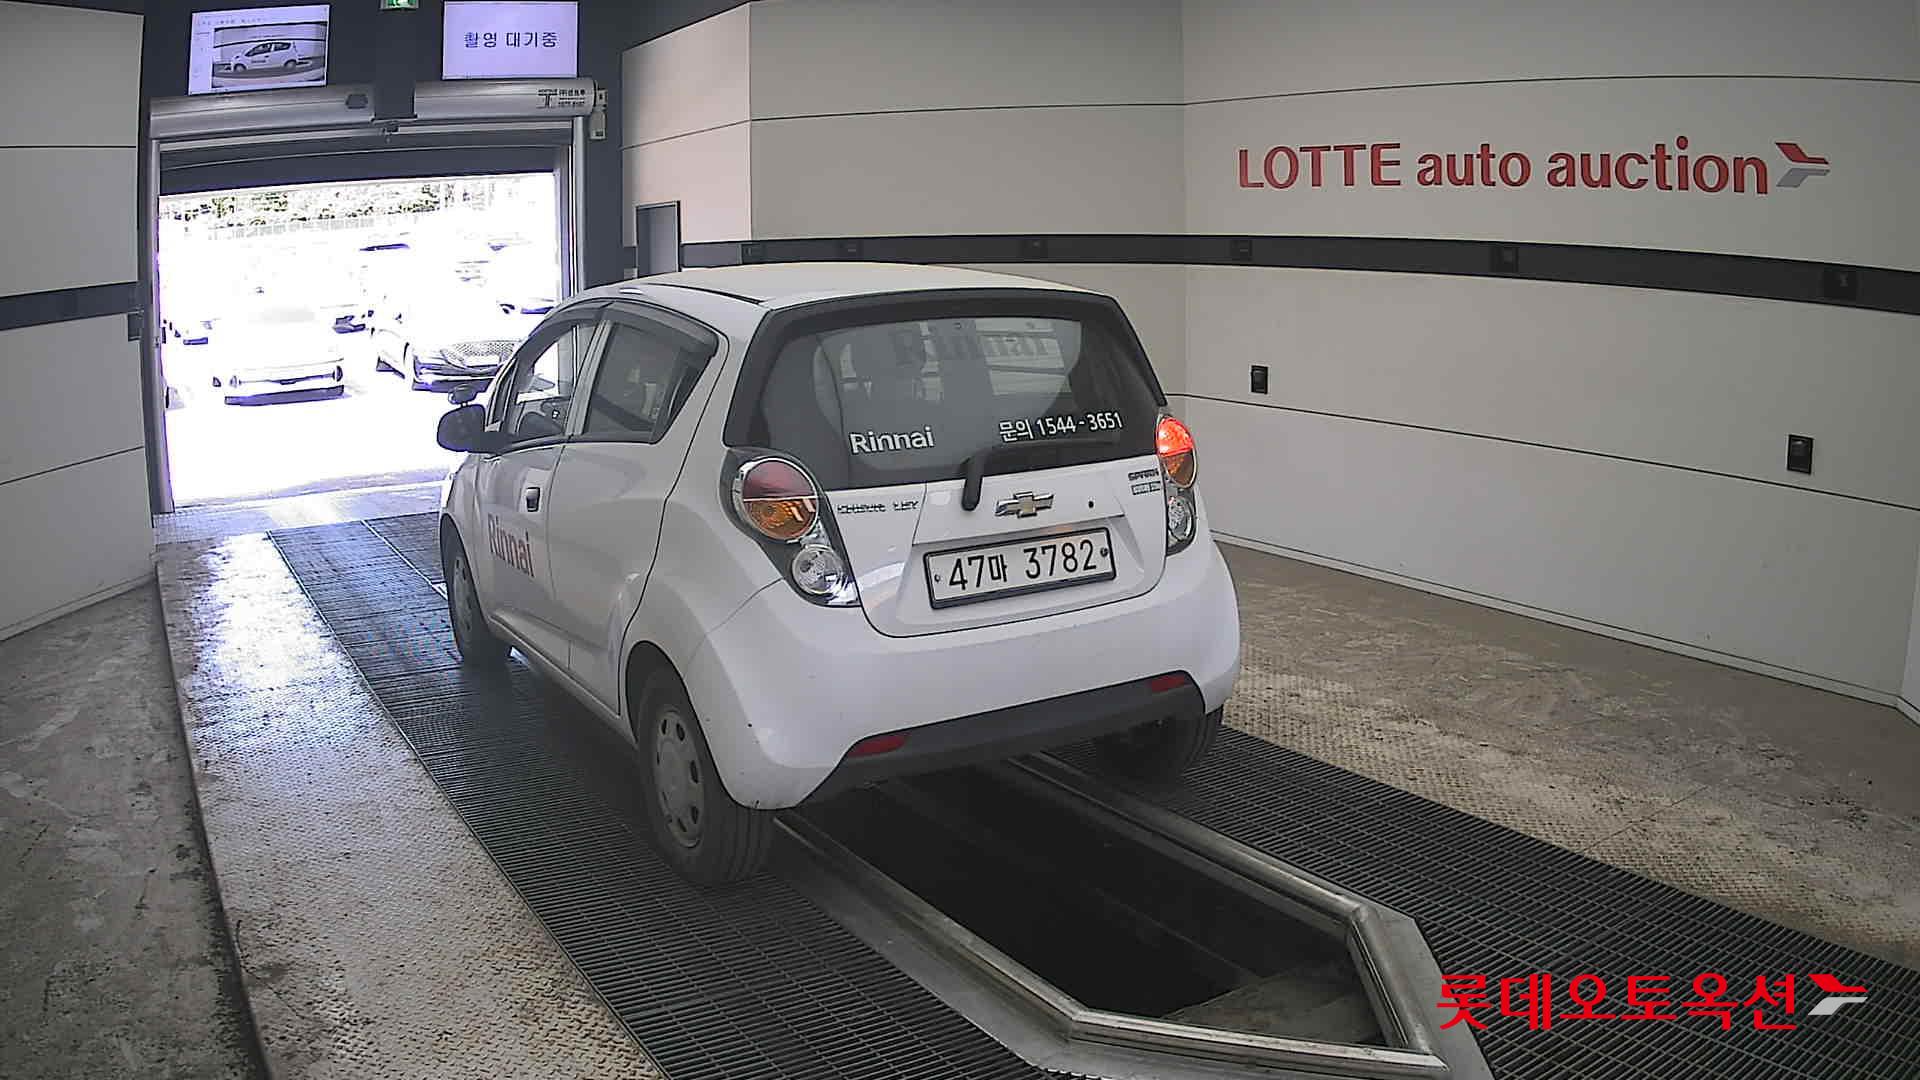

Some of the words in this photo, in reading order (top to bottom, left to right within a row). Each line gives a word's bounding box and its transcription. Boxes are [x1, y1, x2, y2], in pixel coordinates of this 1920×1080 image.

[464, 31, 498, 48] 촬영
[505, 31, 559, 48] 대기중
[1238, 142, 1401, 189] LOTTE
[1416, 143, 1532, 188] auto
[1546, 135, 1769, 195] auction
[849, 426, 935, 454] Rinnai
[1000, 418, 1035, 443] 문의
[487, 513, 535, 578] Rinnai
[949, 554, 1008, 590] 47마
[1023, 539, 1097, 579] 3782
